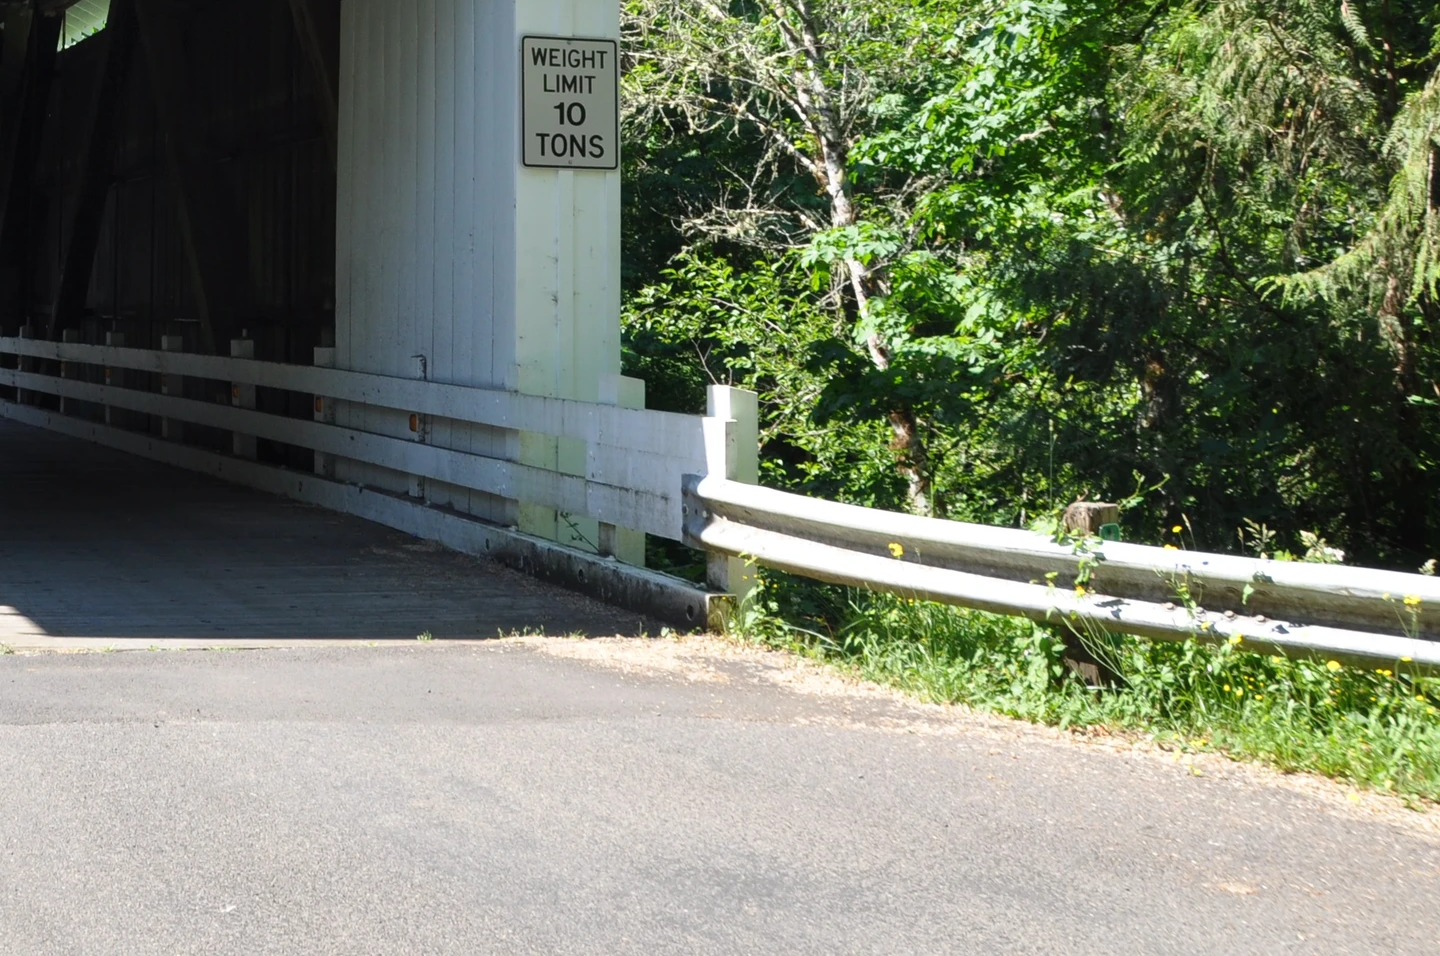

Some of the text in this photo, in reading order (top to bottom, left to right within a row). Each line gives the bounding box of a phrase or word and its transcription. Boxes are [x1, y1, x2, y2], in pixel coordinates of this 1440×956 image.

[531, 47, 608, 69] WEIGHT
[543, 73, 596, 94] LIMIT
[553, 102, 586, 126] 10
[535, 133, 604, 158] TONS
